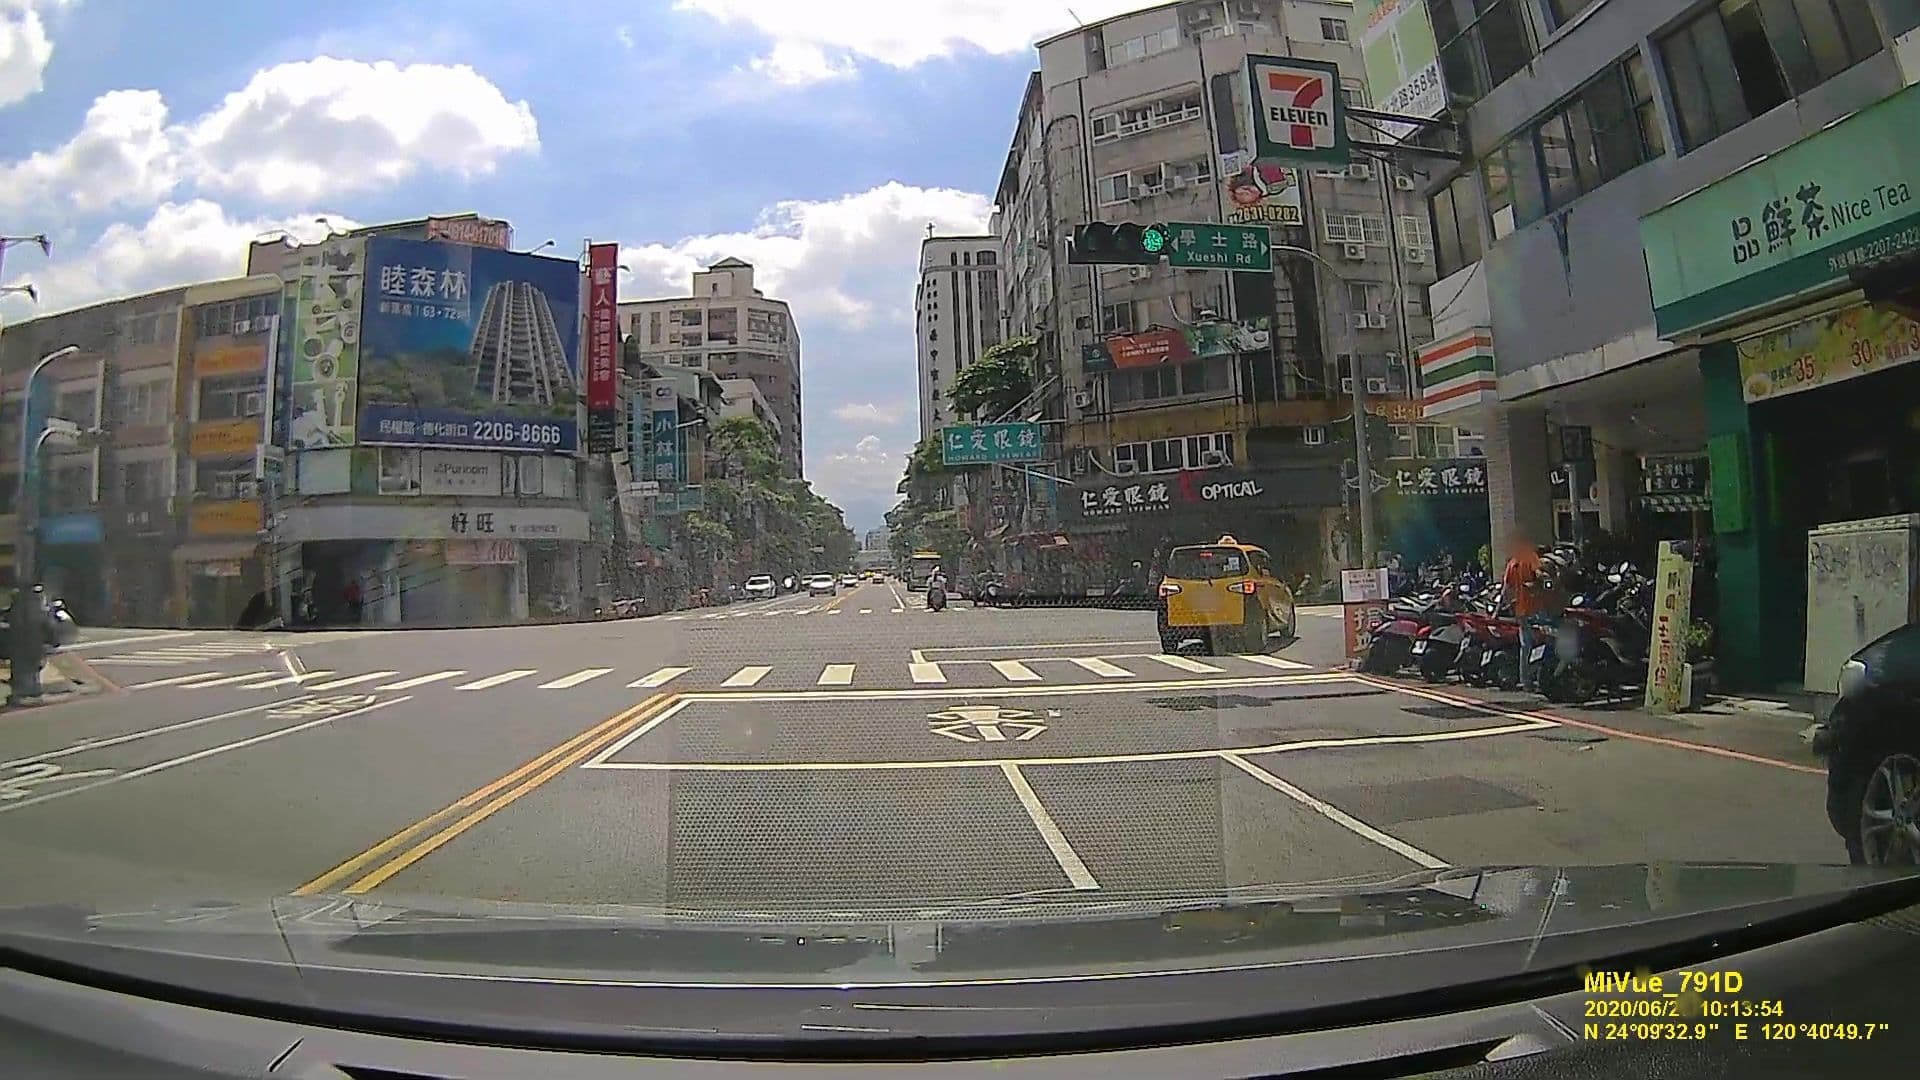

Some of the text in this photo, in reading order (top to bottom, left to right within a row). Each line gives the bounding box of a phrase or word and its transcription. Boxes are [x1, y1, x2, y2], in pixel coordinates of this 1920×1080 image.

[1830, 182, 1912, 229] Nice Tea
[1731, 181, 1829, 264] 品鮮茶
[1179, 228, 1258, 249] 學士路
[1187, 250, 1228, 263] Xueshi
[380, 264, 467, 300] 睦森林
[1793, 355, 1816, 382] 35
[473, 421, 561, 445] 2206-8666
[948, 428, 1037, 451] 仁愛眼鏡
[1395, 466, 1485, 488] 仁愛眼鏡
[1081, 483, 1170, 508] 仁愛眼鏡
[1201, 480, 1264, 501] OPTICAL
[451, 512, 495, 533] 好旺
